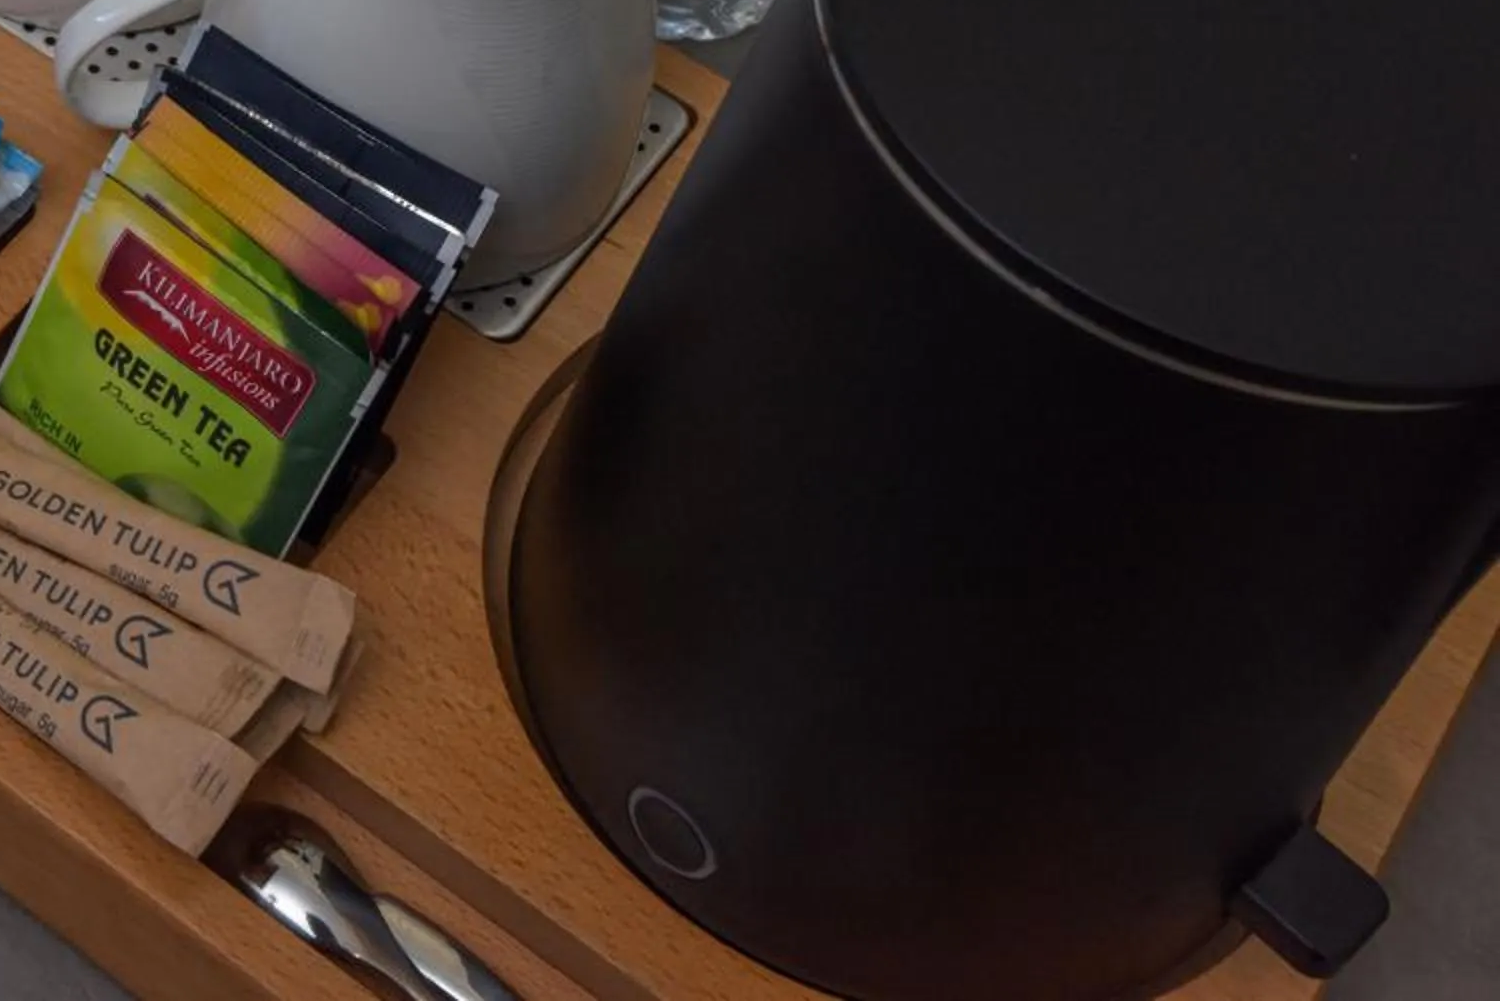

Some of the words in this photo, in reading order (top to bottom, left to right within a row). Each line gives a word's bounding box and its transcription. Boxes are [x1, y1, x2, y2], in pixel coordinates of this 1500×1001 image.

[138, 261, 304, 395] KILIMANJARO
[93, 327, 190, 419] GREEN
[194, 405, 253, 469] TEA
[188, 339, 282, 410] infusions
[28, 398, 64, 439] RICH
[64, 429, 84, 454] IN
[133, 409, 175, 446] Green
[178, 438, 202, 468] Tea
[111, 519, 198, 575] TULIP
[30, 568, 115, 627] TULIP
[108, 562, 152, 594] sugar
[157, 583, 181, 609] 5g
[0, 640, 80, 705] TULIP
